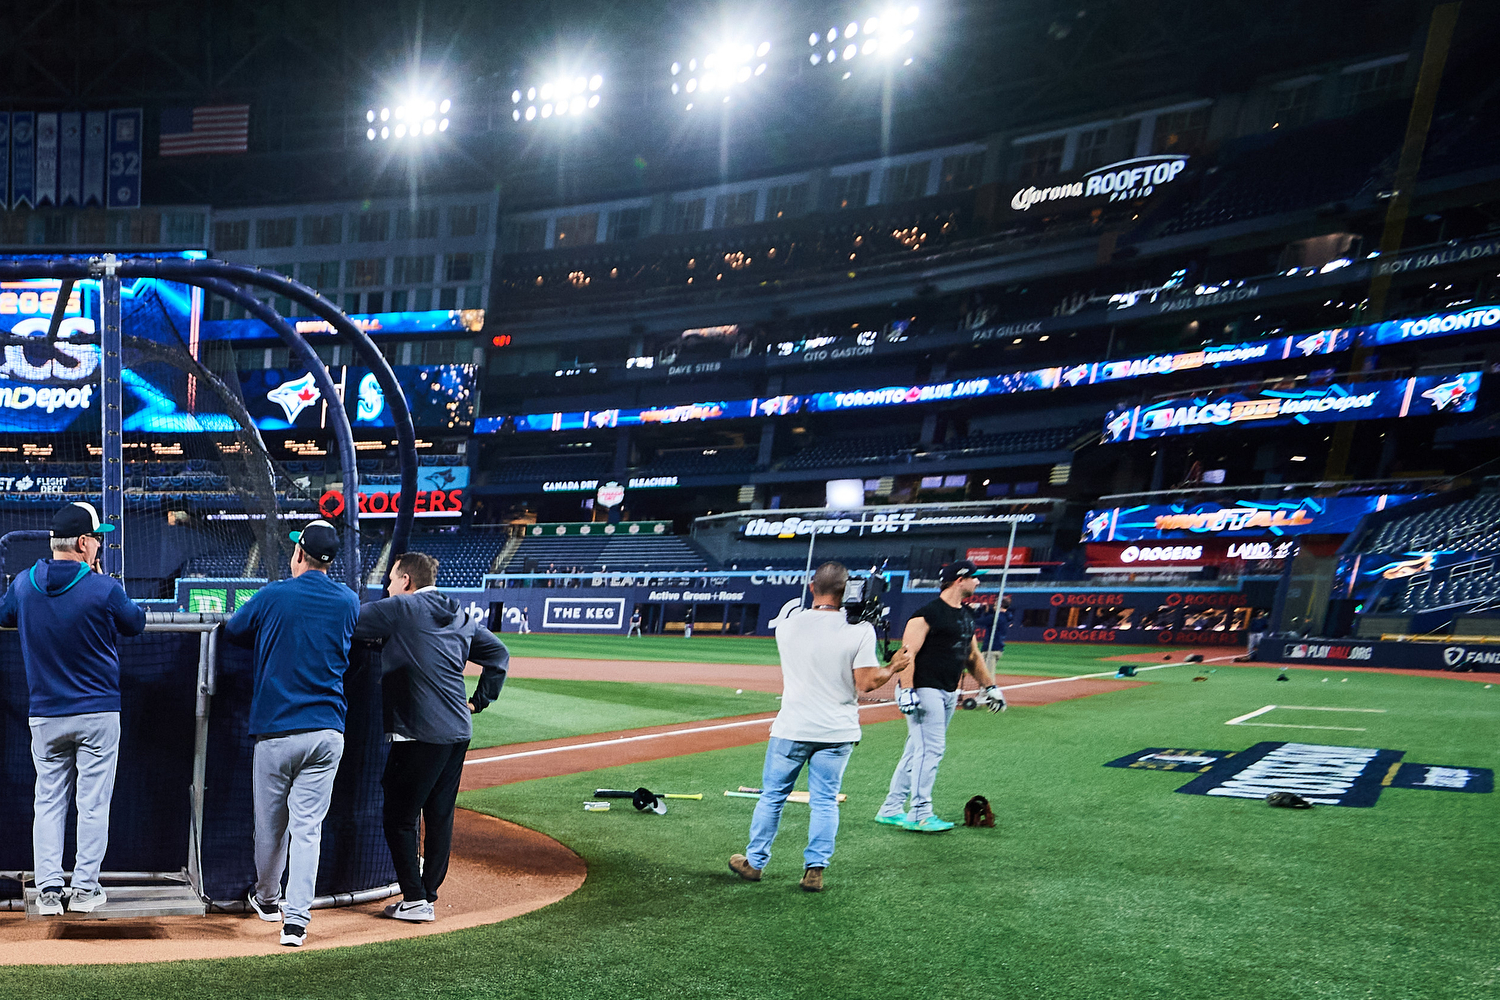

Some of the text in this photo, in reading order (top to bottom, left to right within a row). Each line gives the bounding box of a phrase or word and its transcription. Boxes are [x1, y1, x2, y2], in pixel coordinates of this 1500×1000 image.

[110, 152, 139, 176] 32
[1010, 160, 1186, 211] Corona ROOFTOP
[1108, 186, 1153, 203] PATIO
[1379, 258, 1412, 275] ROY
[1400, 308, 1500, 339] TORONTO
[972, 322, 1041, 341] PAT GILLICK
[804, 346, 874, 362] CITO GASTON
[669, 365, 692, 376] DAVE
[835, 379, 990, 407] TORONTO BLUE JAYS
[1172, 403, 1232, 426] ALCS
[1280, 391, 1380, 414] loanDepot
[36, 477, 68, 486] FLIGHT
[41, 485, 64, 493] DECK
[542, 479, 599, 491] CANADA DRY
[629, 476, 678, 488] BLEACHERS
[745, 516, 853, 536] theScore
[871, 513, 916, 533] BET
[1138, 546, 1203, 561] ROGERS
[649, 591, 680, 601] Active
[1067, 594, 1123, 605] ROGERS
[1184, 593, 1248, 605] ROGERS
[553, 608, 614, 619] THE KEG
[1060, 629, 1116, 641] ROGERS
[1180, 630, 1238, 643] ROGERS
[1306, 645, 1372, 660] PLAYBALL.ORG
